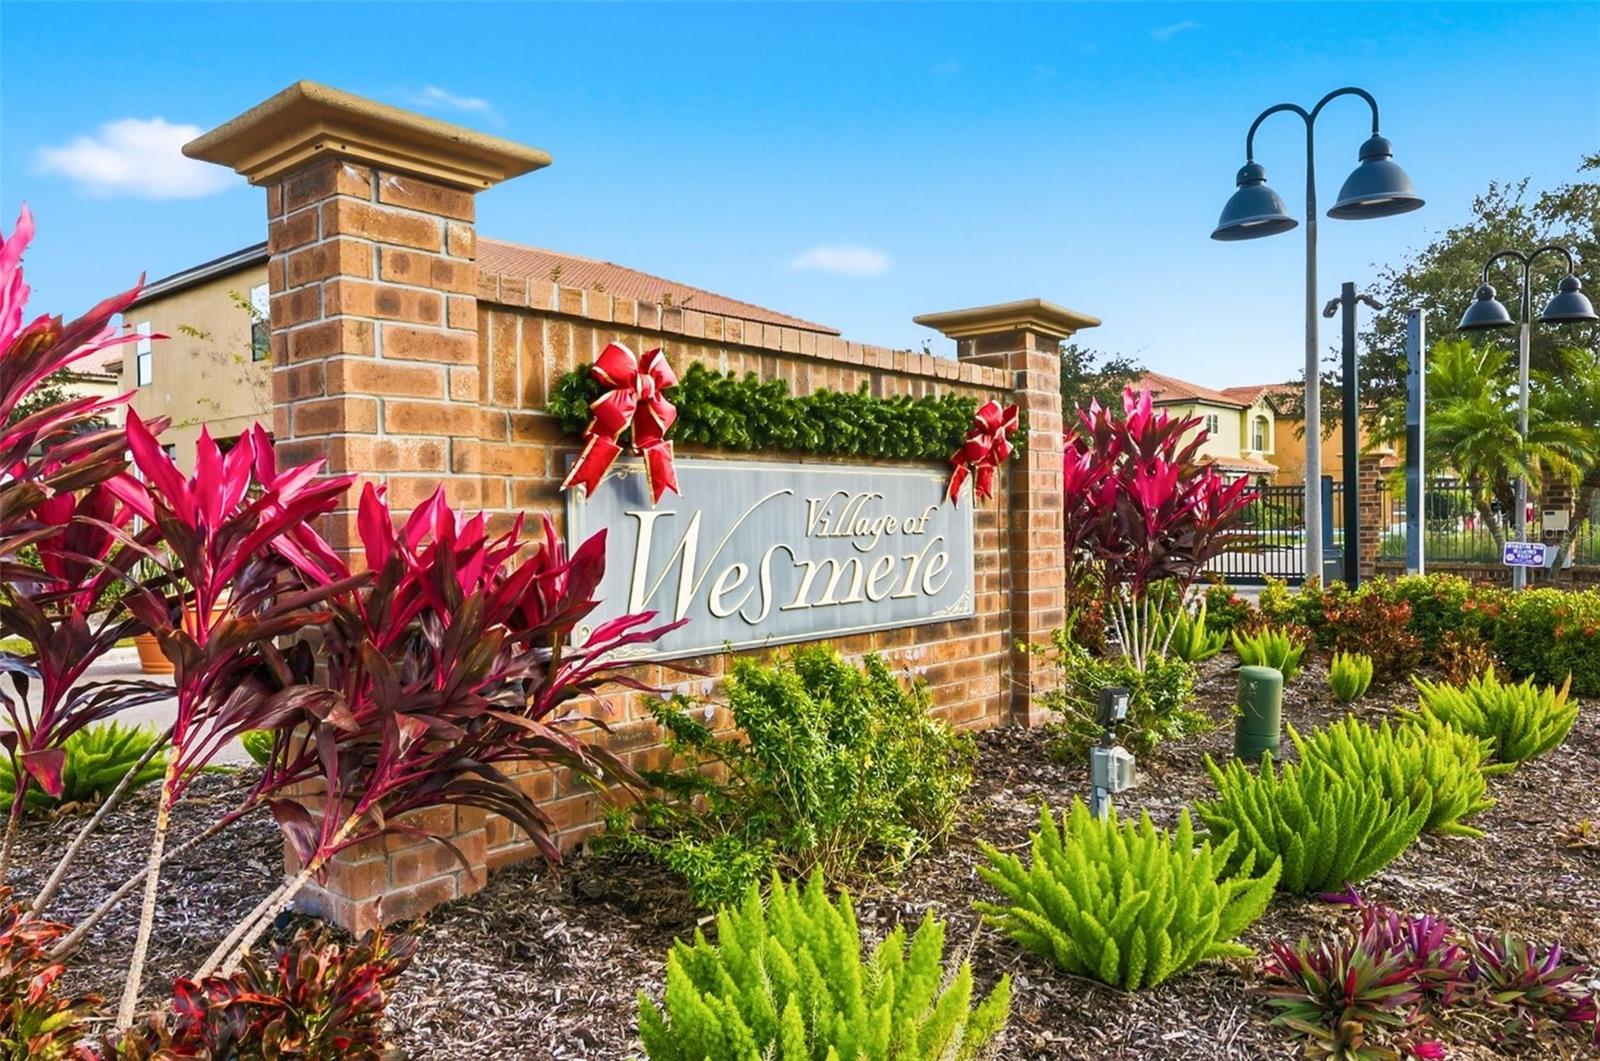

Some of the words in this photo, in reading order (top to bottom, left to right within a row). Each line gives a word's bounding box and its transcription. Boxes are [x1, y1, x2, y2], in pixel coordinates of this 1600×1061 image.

[625, 488, 953, 626] Wesmere
[805, 489, 899, 552] Village
[901, 505, 938, 535] of
